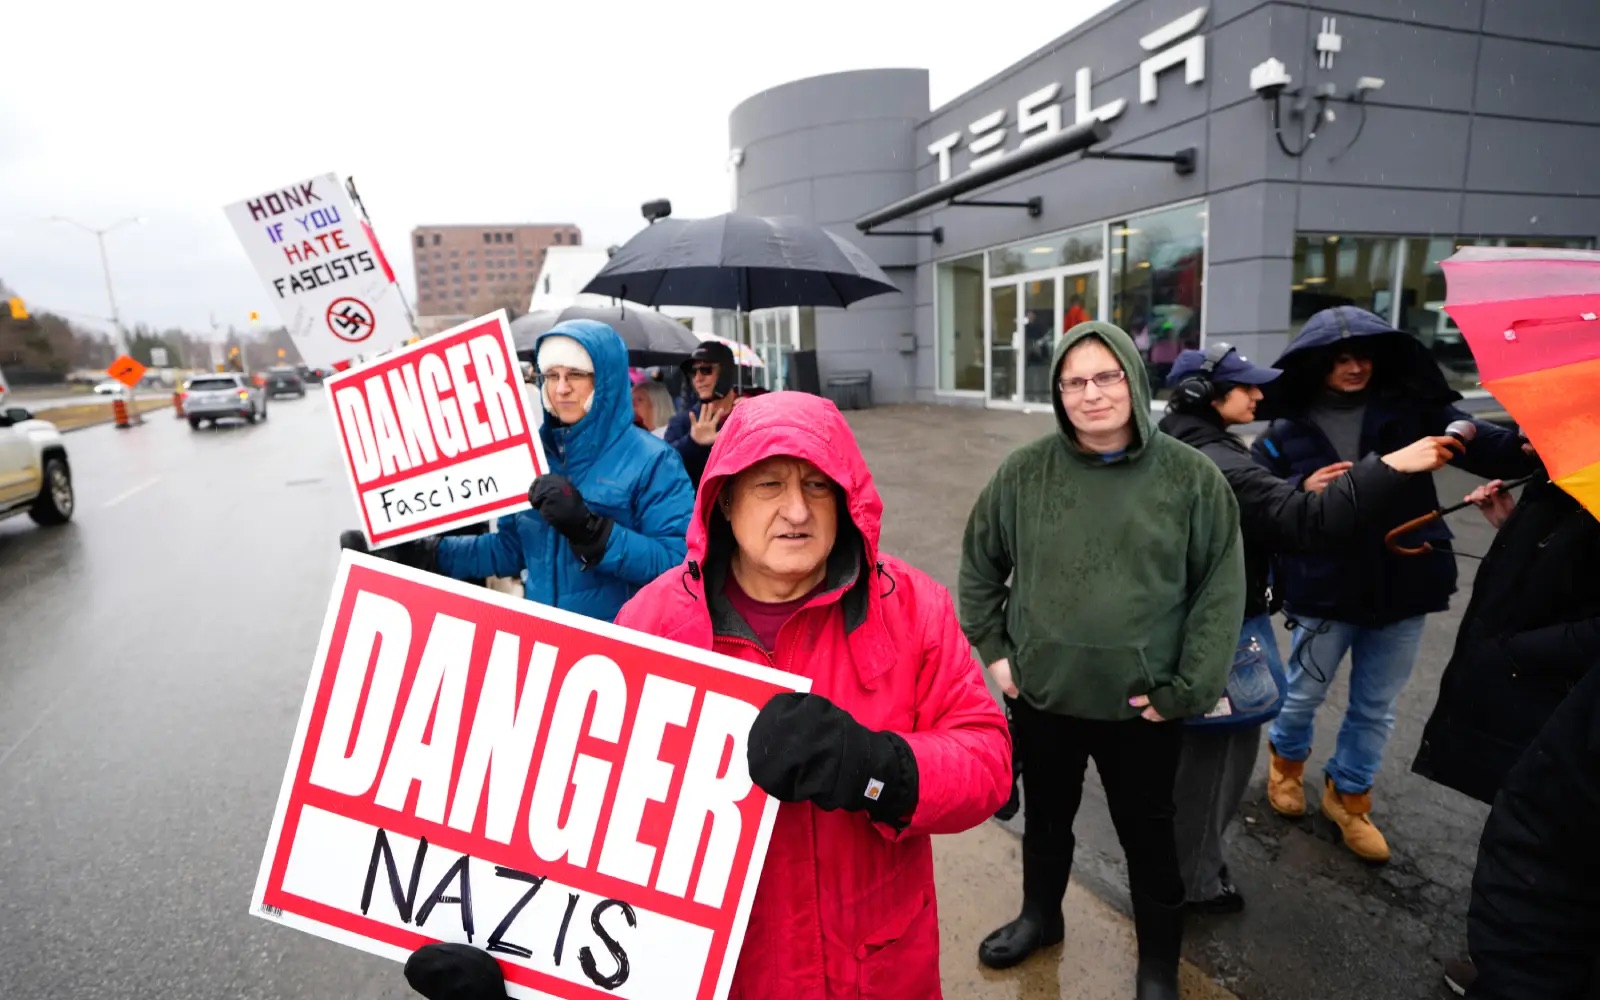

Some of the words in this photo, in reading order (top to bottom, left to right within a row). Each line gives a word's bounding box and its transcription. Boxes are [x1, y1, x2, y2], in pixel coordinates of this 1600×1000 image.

[928, 6, 1209, 182] TESLA
[247, 180, 322, 222] HONK
[265, 222, 283, 244] IF
[295, 205, 341, 231] YOU
[284, 229, 350, 265] HATE
[272, 250, 375, 298] FASCISTS
[335, 333, 525, 485] DANGER
[379, 475, 499, 523] Fascism
[308, 589, 761, 910] DANGER
[360, 827, 637, 990] NAZIS
